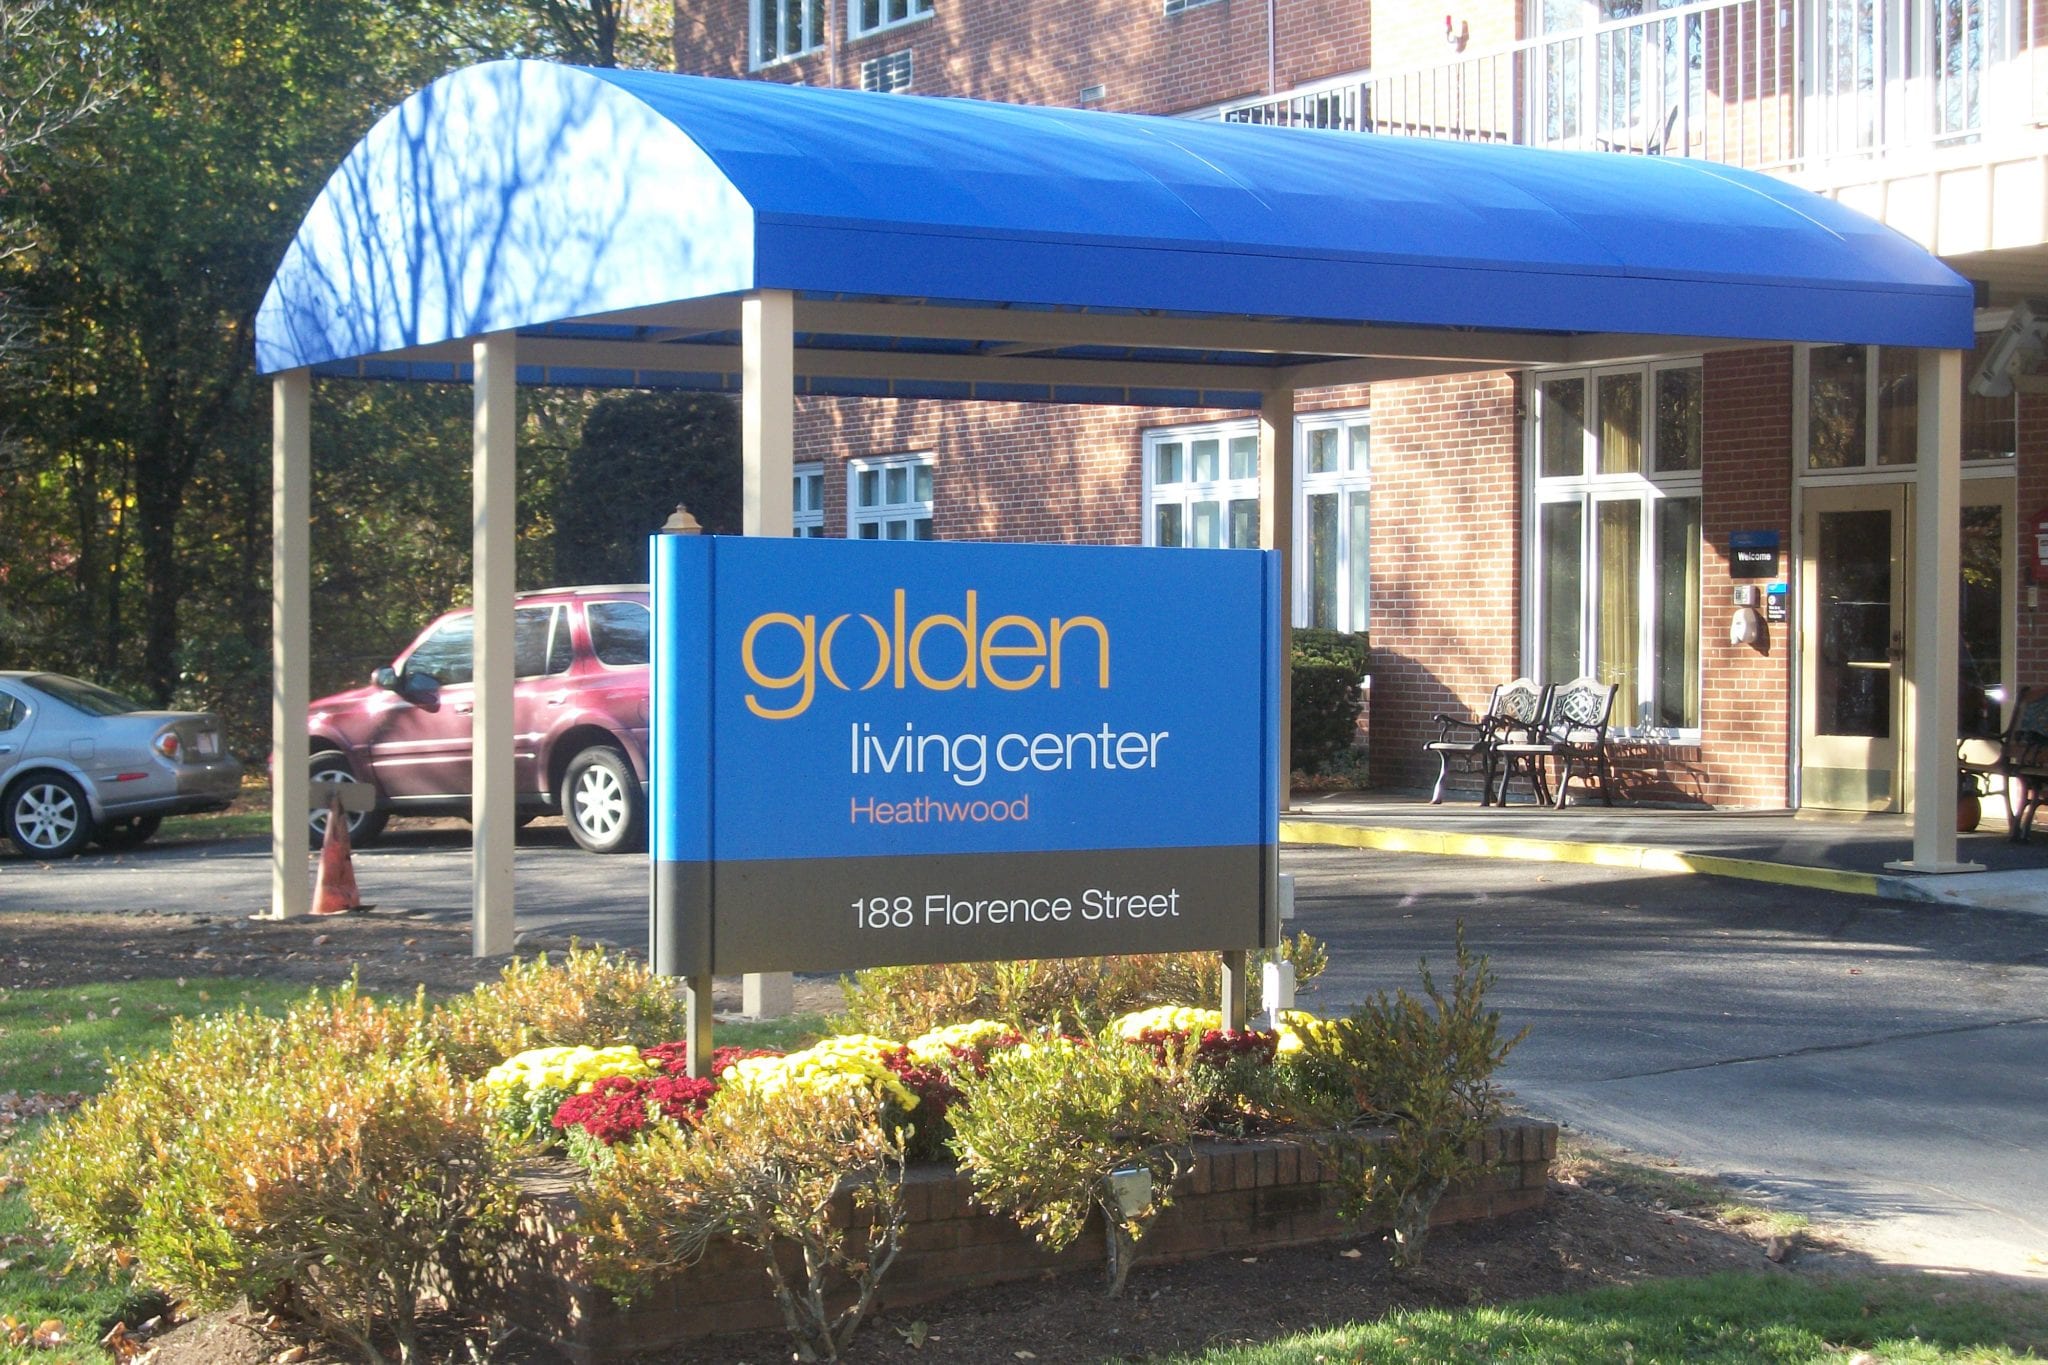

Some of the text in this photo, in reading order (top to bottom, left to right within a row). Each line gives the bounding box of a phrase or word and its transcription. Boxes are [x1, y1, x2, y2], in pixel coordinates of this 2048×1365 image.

[1737, 551, 1772, 561] Welcome
[741, 588, 1110, 720] golden
[850, 794, 1029, 824] Heathwood
[850, 887, 1181, 929] 188 Florence Street
